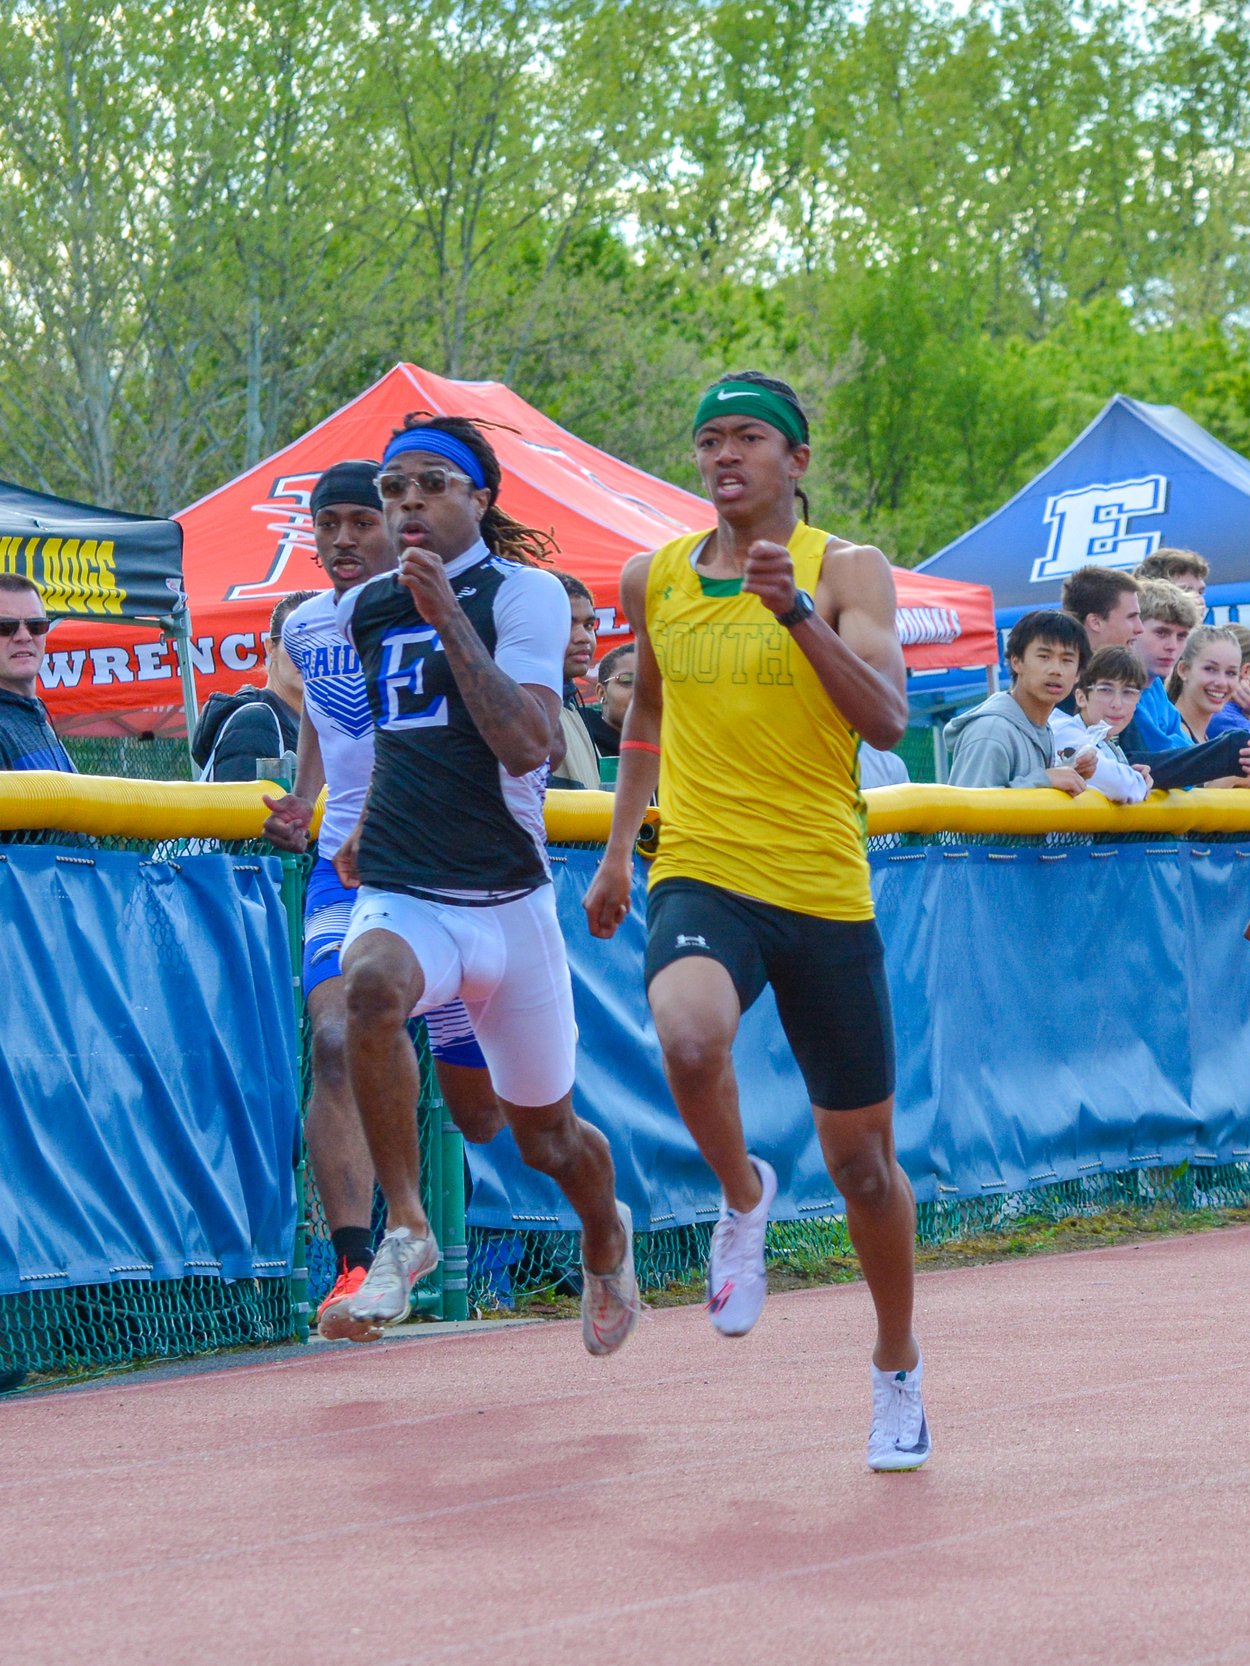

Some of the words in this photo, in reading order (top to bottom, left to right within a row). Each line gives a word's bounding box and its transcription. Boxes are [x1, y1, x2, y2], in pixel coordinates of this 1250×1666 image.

[1030, 474, 1168, 583] E
[0, 536, 127, 614] LDOGS
[37, 631, 270, 689] WRENC
[302, 643, 365, 681] RAID
[376, 623, 449, 731] E
[653, 619, 794, 686] SOUTH
